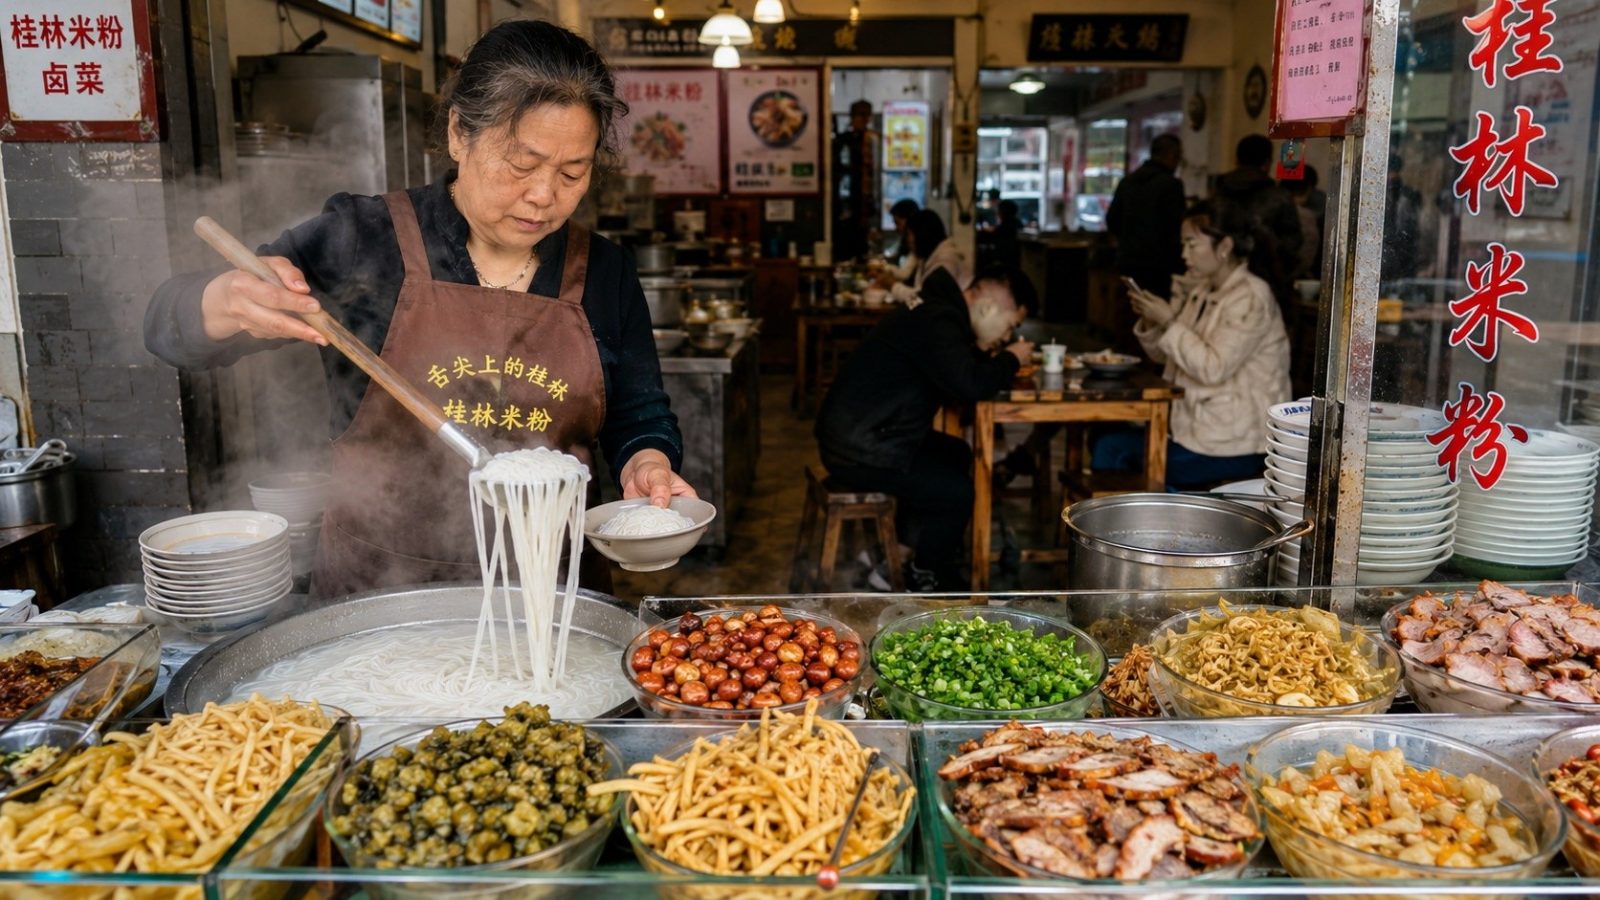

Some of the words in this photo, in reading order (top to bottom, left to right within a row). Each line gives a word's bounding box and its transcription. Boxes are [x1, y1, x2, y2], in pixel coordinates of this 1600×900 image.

[9, 14, 124, 50] 桂林米粉
[41, 61, 105, 96] 卤菜
[1426, 0, 1564, 490] 桂林米粉
[442, 398, 553, 433] 桂林米粉
